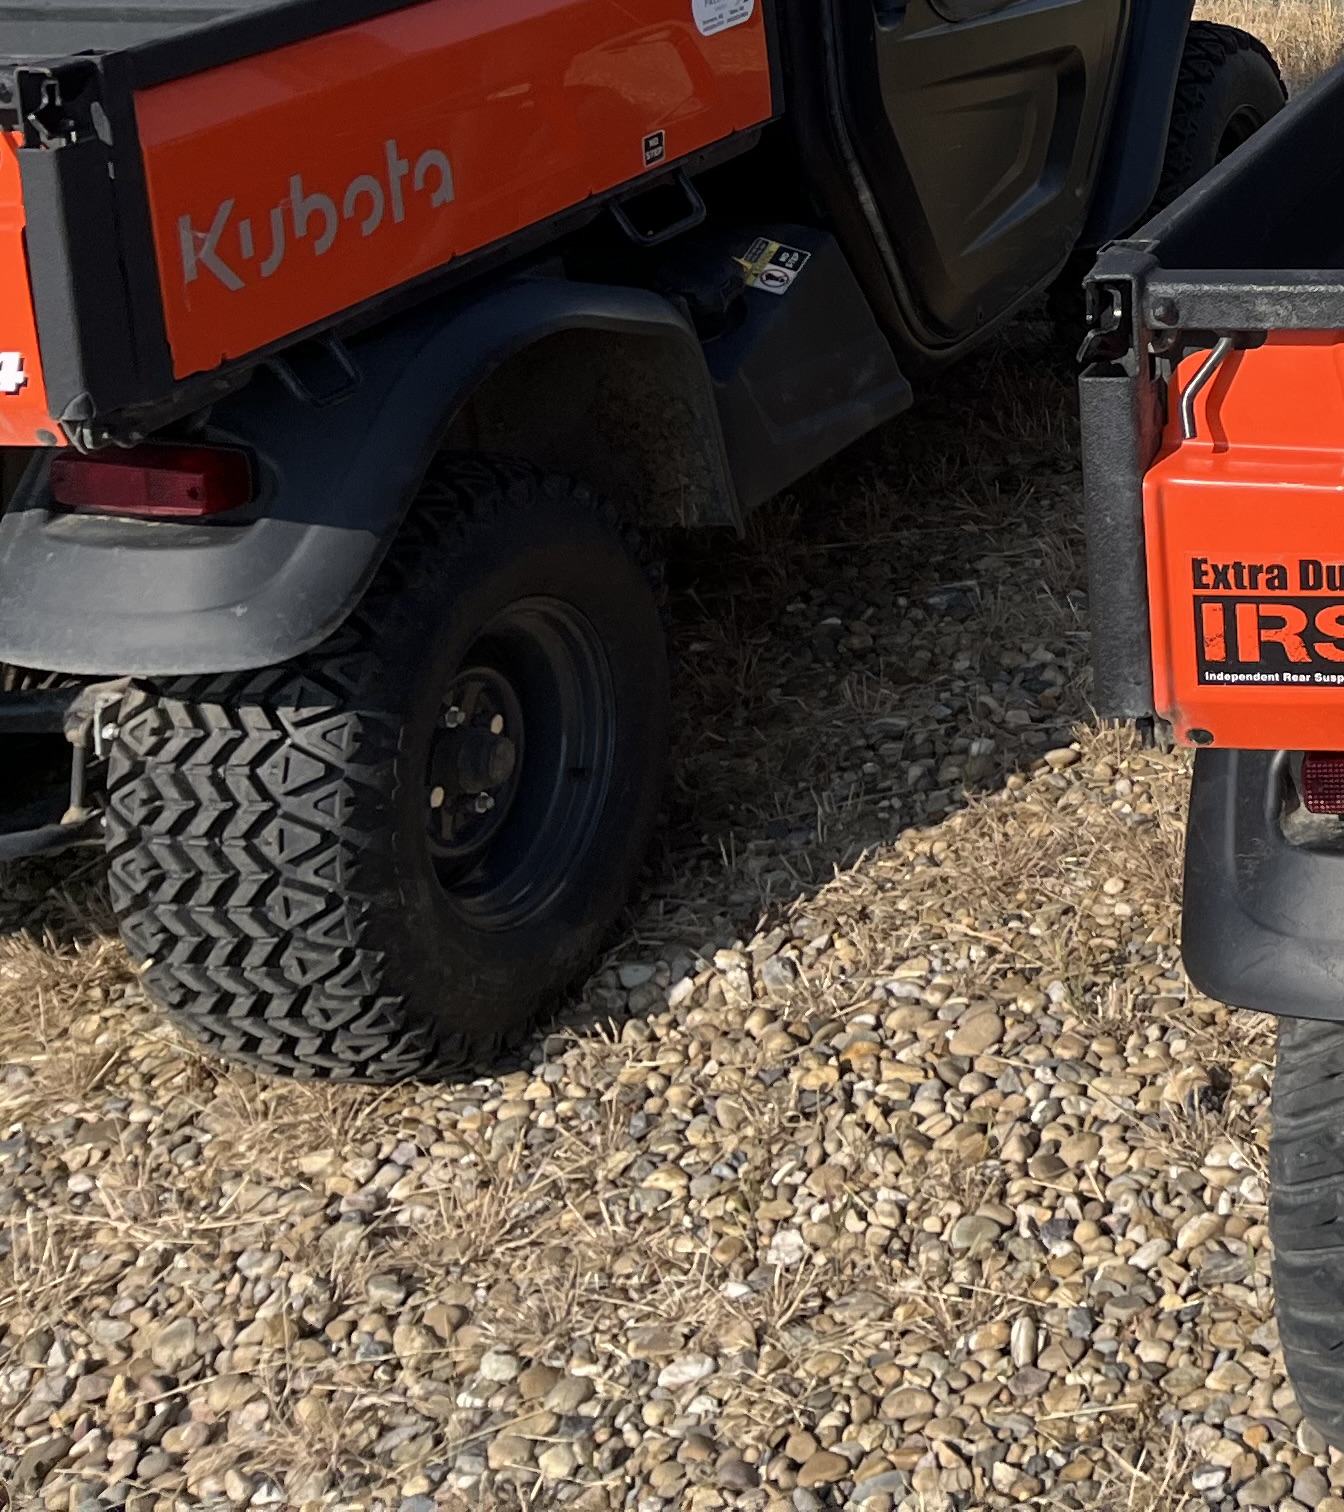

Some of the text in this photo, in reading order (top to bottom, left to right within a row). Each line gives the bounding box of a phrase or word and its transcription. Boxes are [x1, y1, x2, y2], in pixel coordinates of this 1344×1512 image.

[178, 138, 455, 292] Kubota
[1191, 557, 1288, 591] Extra
[1204, 671, 1279, 683] Independent
[1282, 672, 1311, 682] Rear
